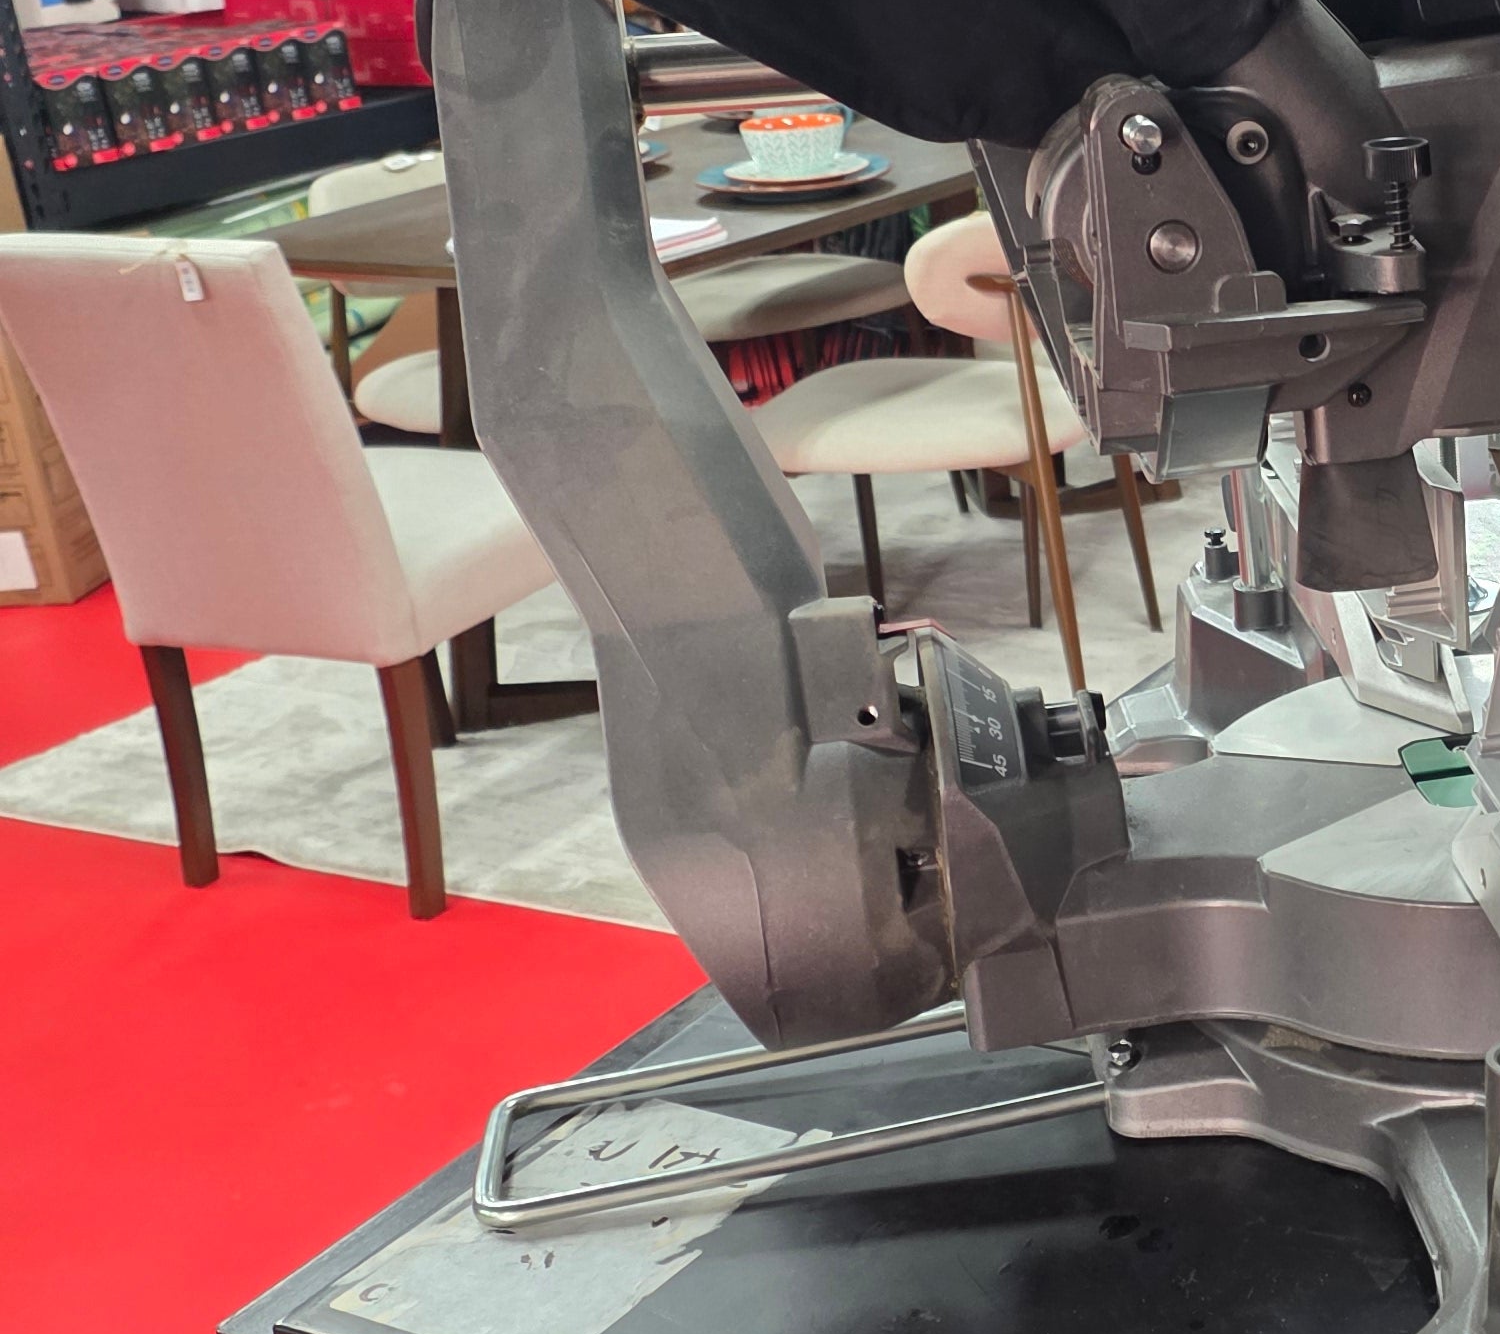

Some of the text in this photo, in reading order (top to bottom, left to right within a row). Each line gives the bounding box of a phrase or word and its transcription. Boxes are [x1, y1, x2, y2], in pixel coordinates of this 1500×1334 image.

[981, 685, 998, 704] 15
[987, 717, 1004, 742] 30
[992, 753, 1009, 778] 45
